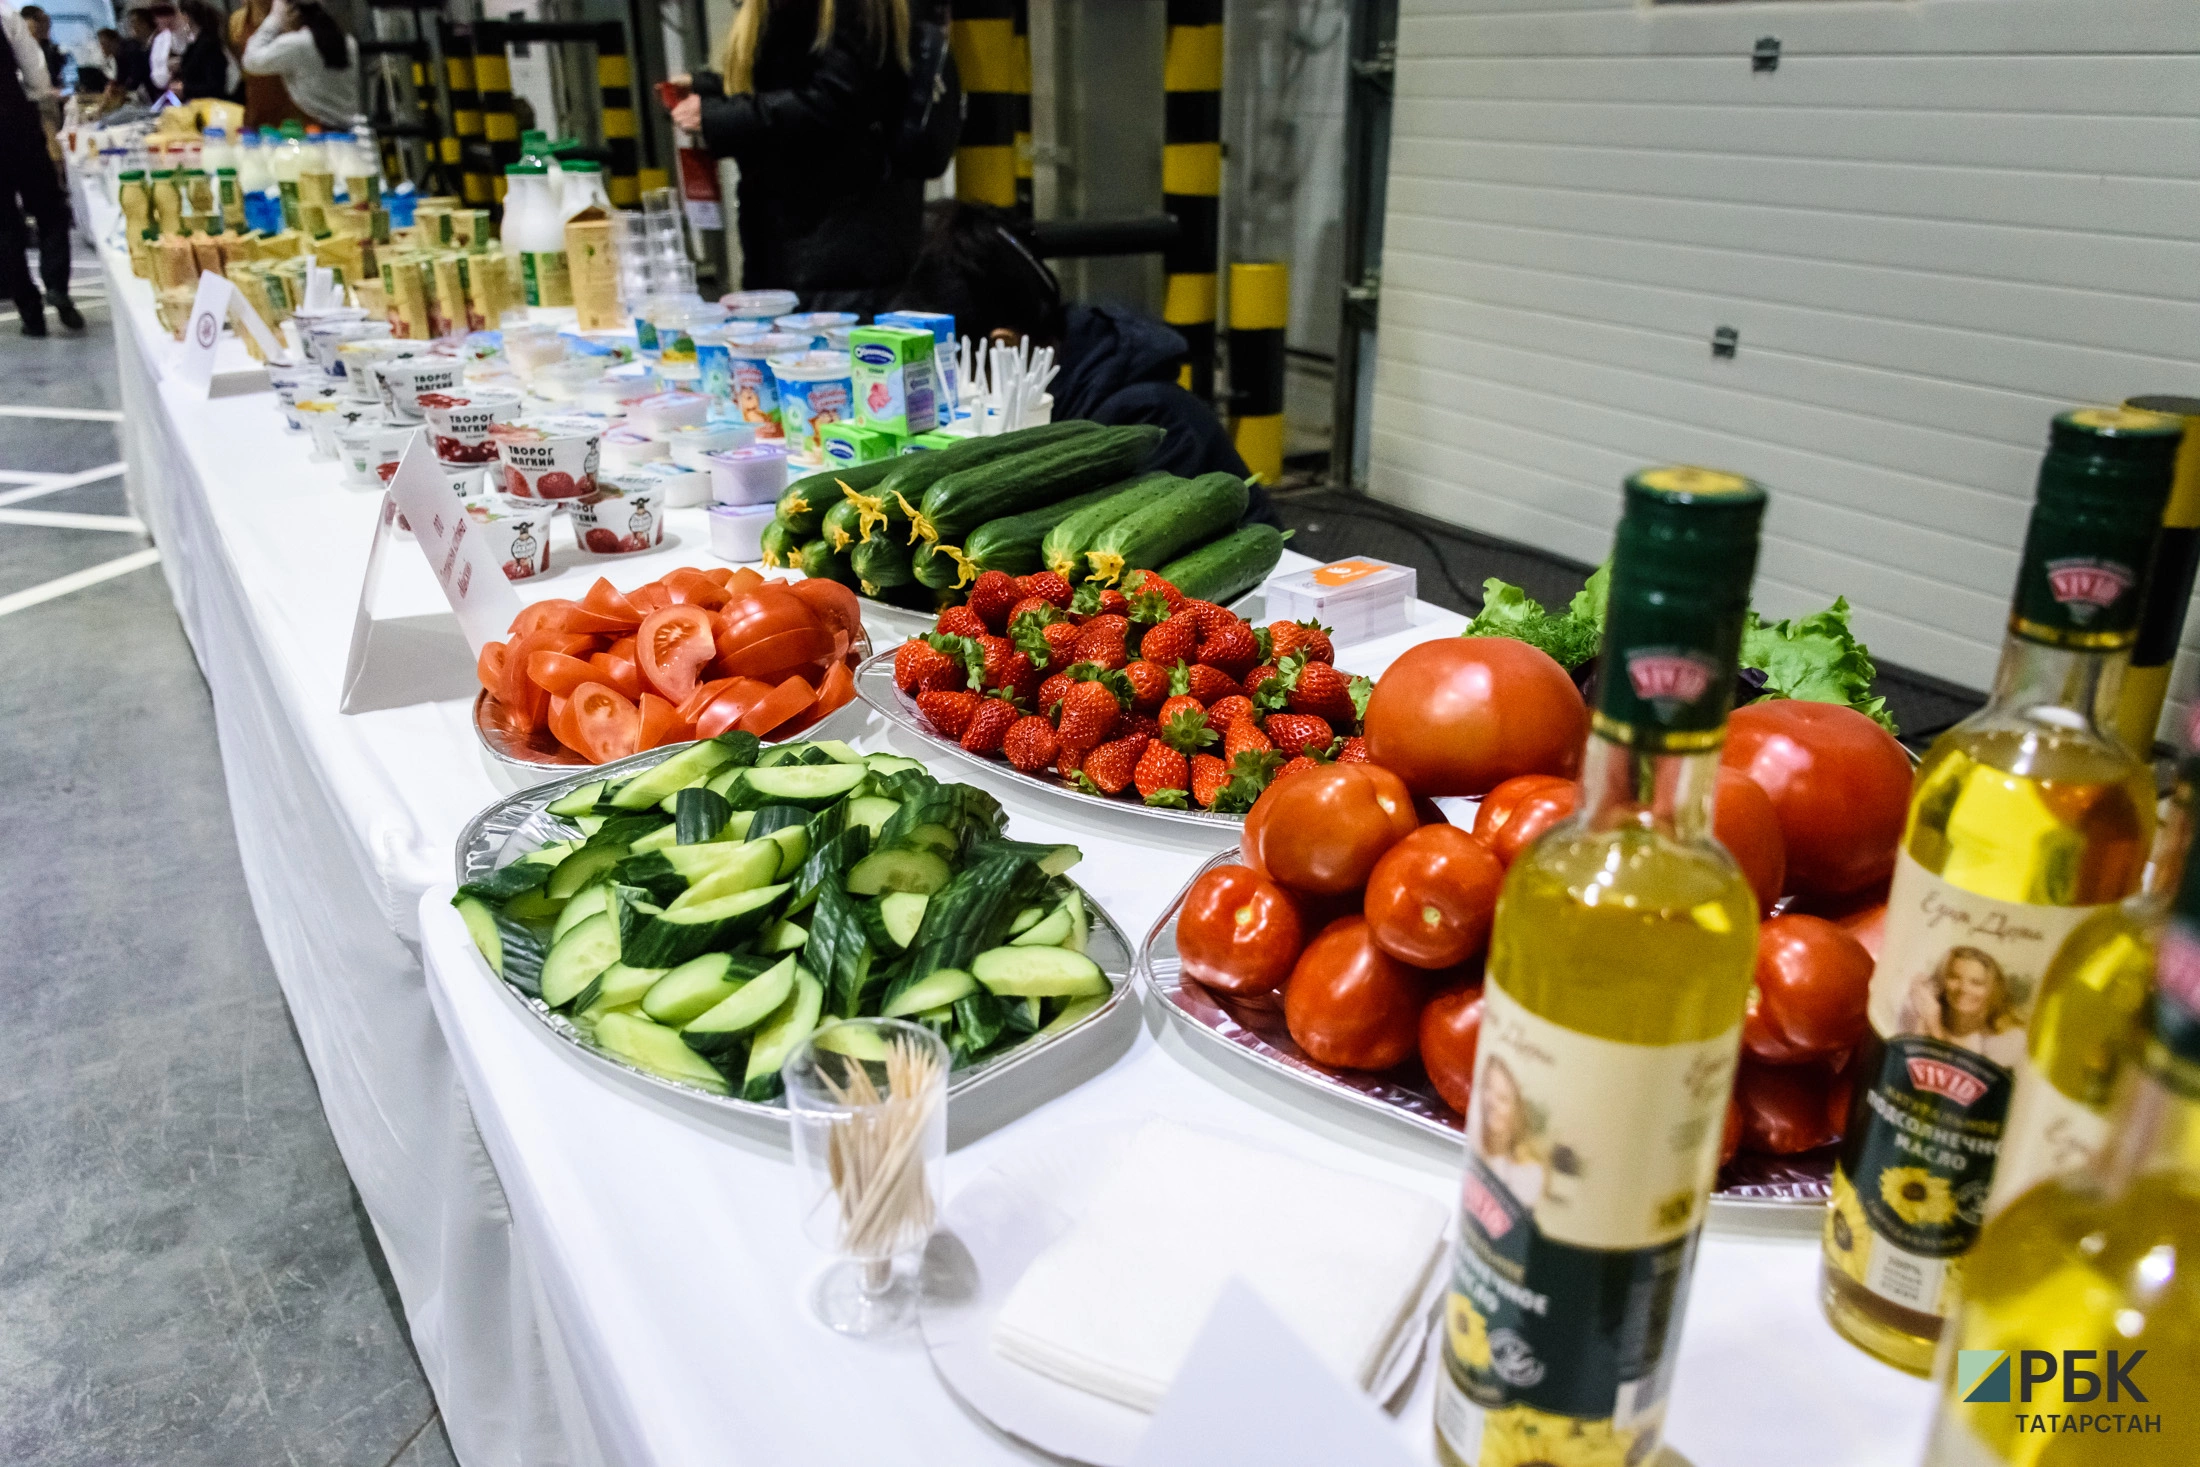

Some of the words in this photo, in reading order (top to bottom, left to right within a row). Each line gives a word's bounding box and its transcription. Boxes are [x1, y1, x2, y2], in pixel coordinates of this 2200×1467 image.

[449, 413, 494, 423] ТВОРОГ
[451, 424, 488, 433] МЯГКИ
[508, 445, 554, 456] ТВОРОГ
[510, 456, 555, 467] МЯГКИЙ
[1911, 1062, 1979, 1102] VIVID
[1894, 1132, 1967, 1171] МАСЛО
